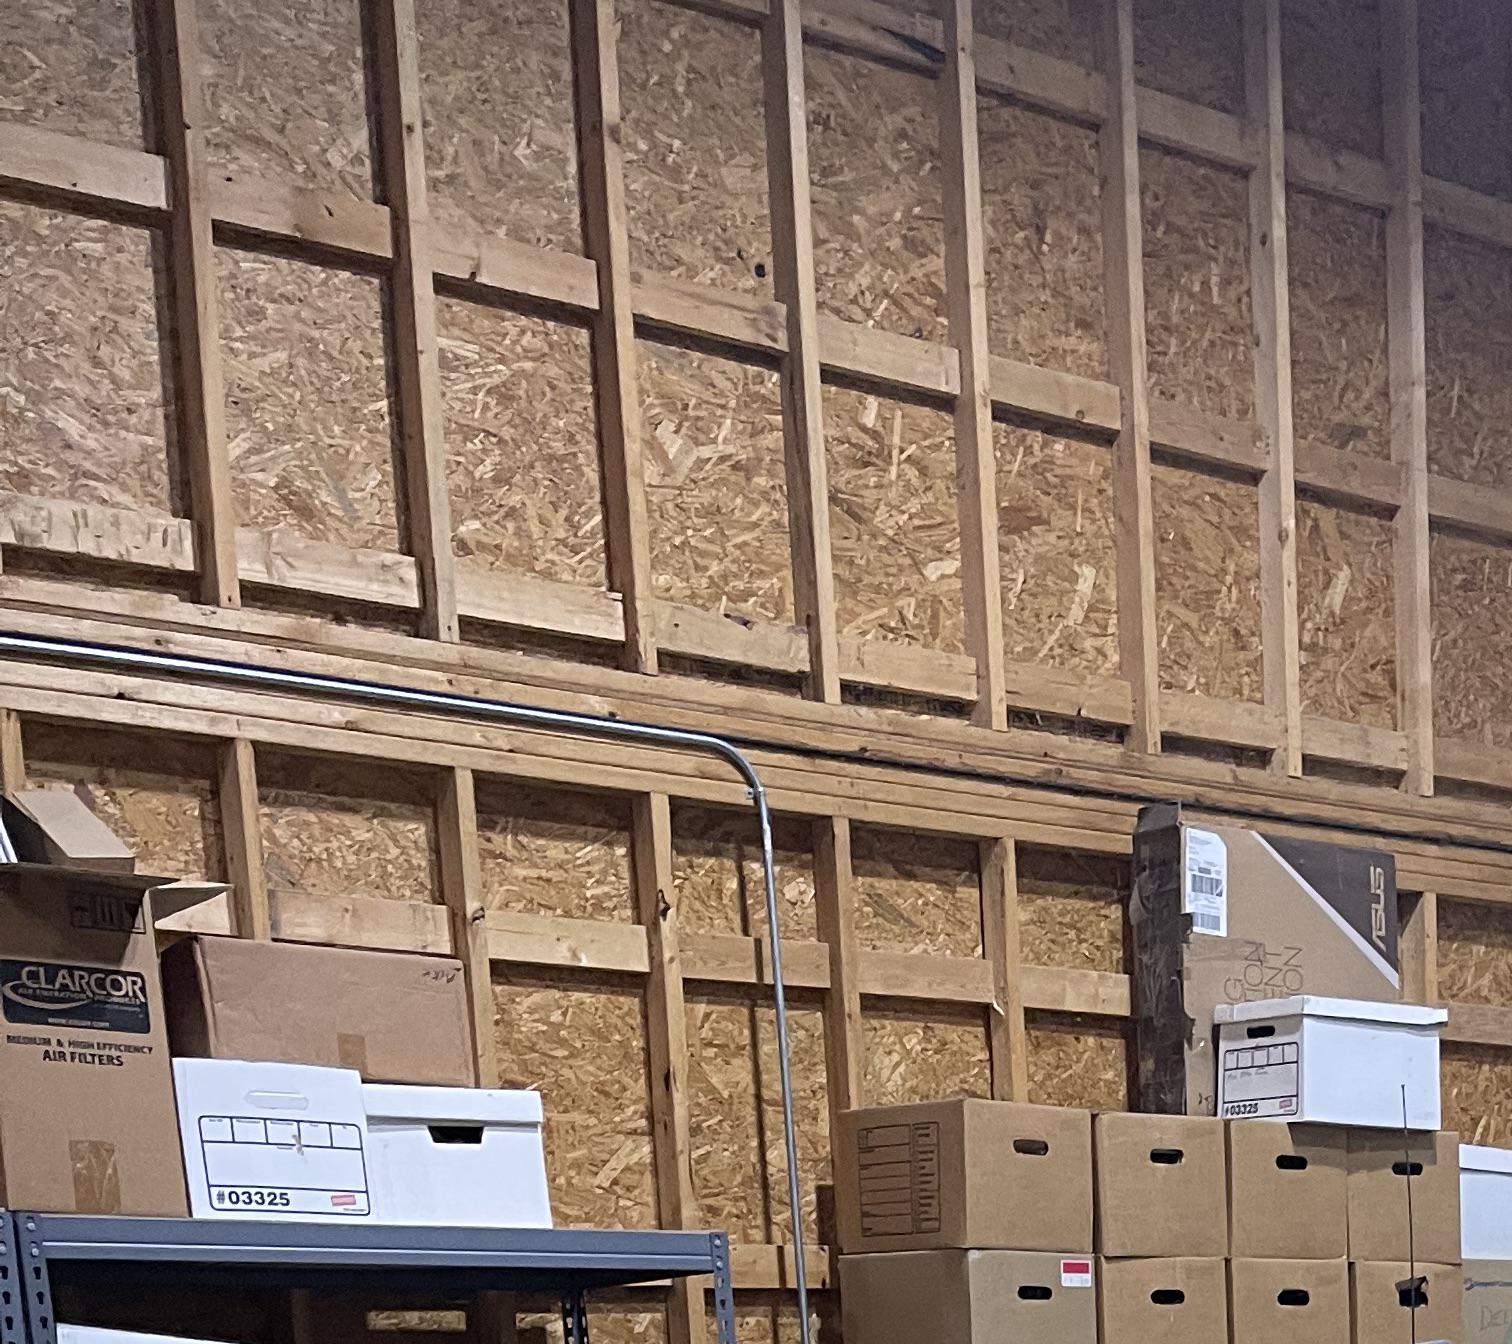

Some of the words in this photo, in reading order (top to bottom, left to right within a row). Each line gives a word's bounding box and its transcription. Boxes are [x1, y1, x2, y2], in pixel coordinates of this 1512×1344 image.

[1369, 864, 1387, 951] ASUS
[21, 965, 147, 1003] CLARCOR
[43, 1049, 67, 1062] AIR
[70, 1051, 124, 1067] FILTERS
[215, 1189, 291, 1208] #03325
